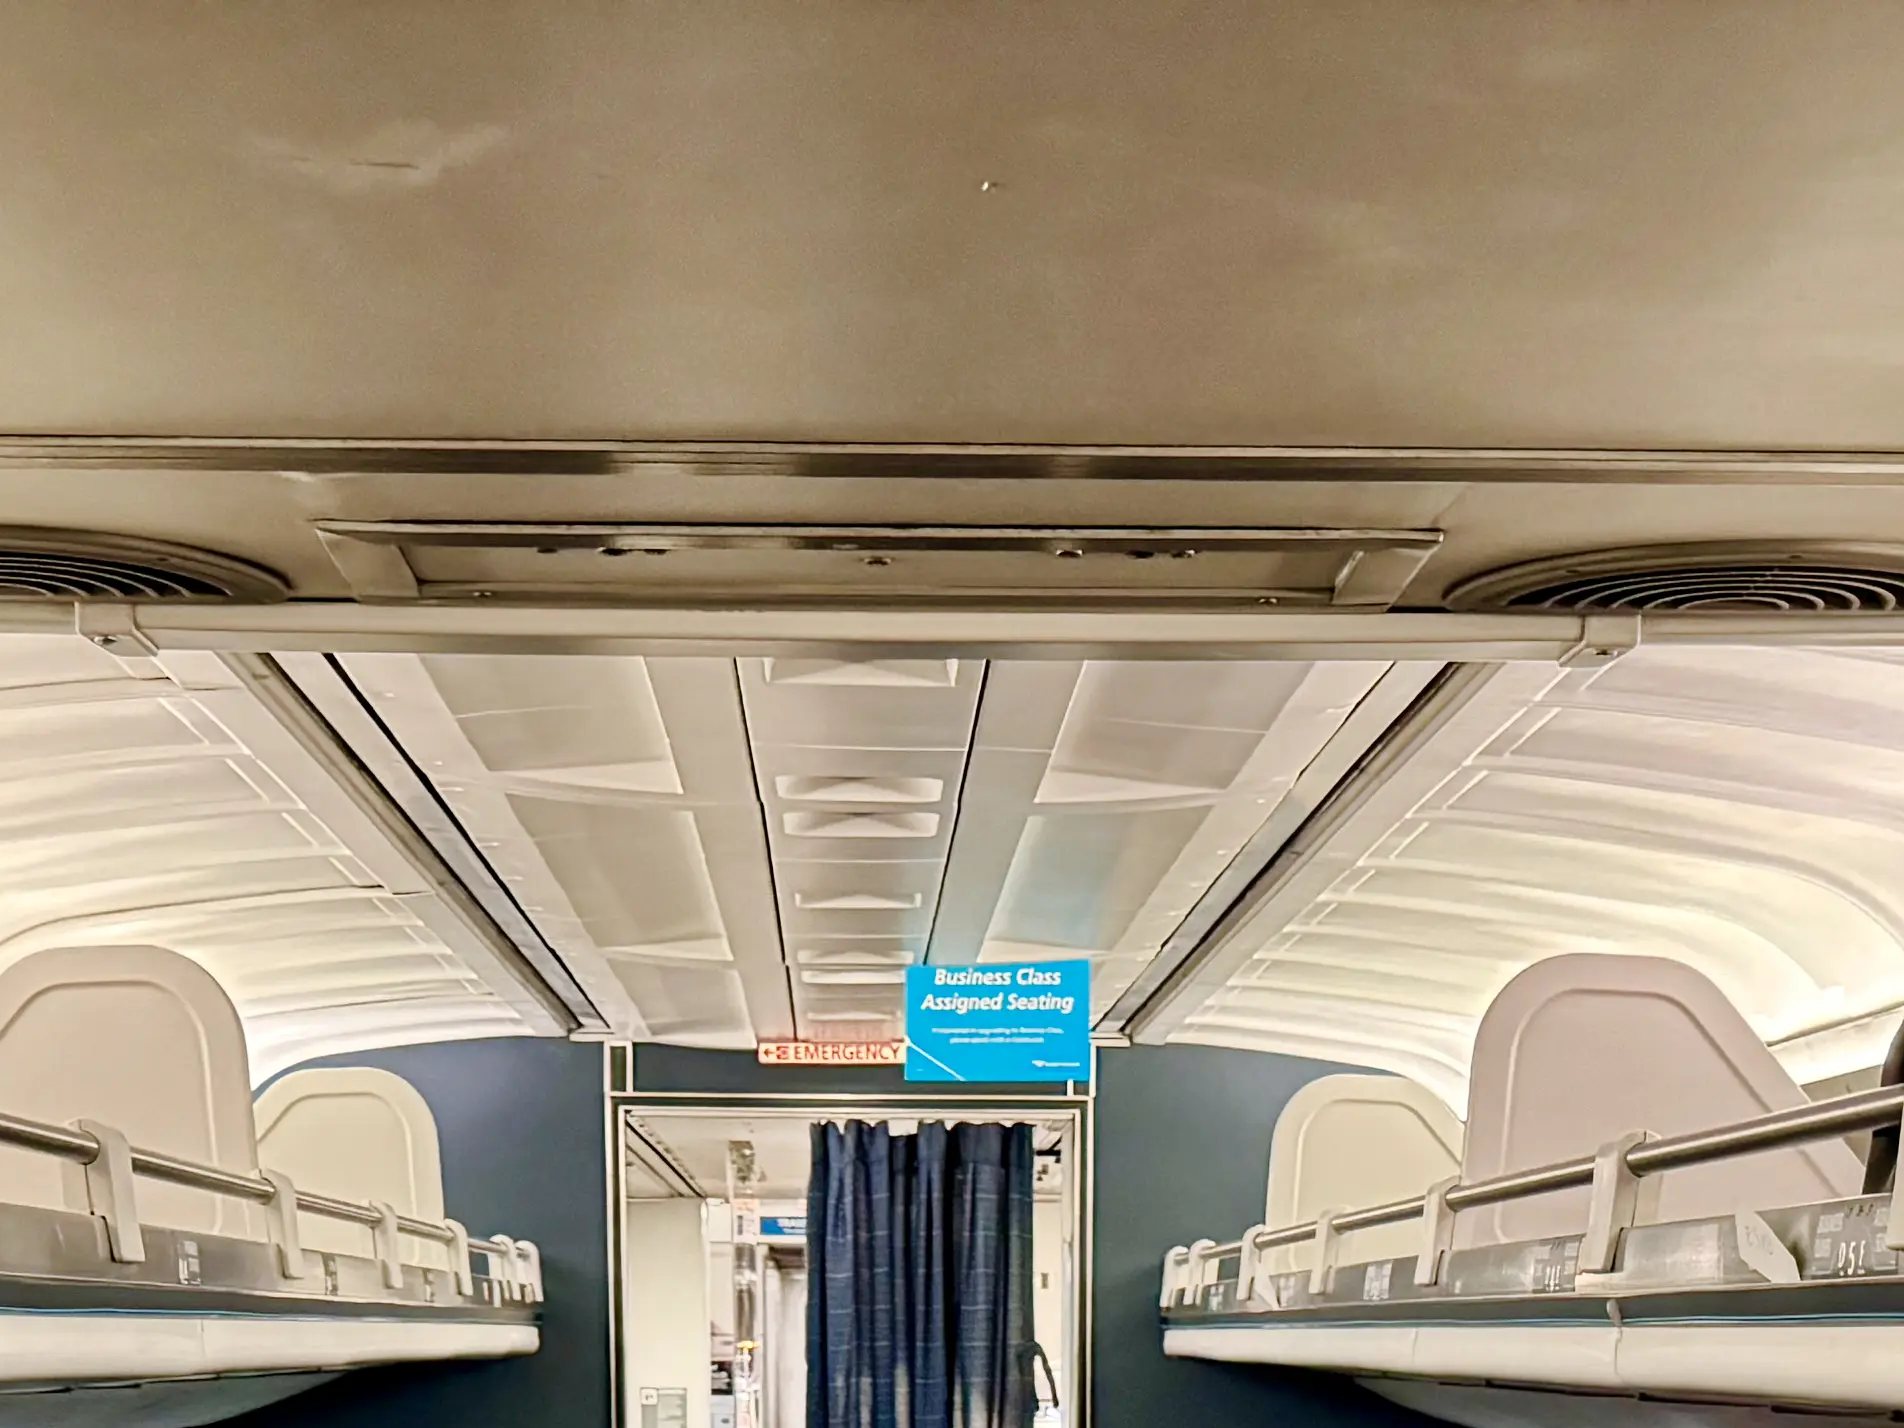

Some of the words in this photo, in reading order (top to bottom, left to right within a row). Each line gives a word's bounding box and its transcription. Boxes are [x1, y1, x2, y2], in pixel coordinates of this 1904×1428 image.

[934, 968, 1012, 986] Business
[1016, 968, 1062, 986] Class
[921, 992, 1004, 1015] Assigned
[1007, 992, 1075, 1015] Seating
[794, 1043, 900, 1061] EMERGENCY
